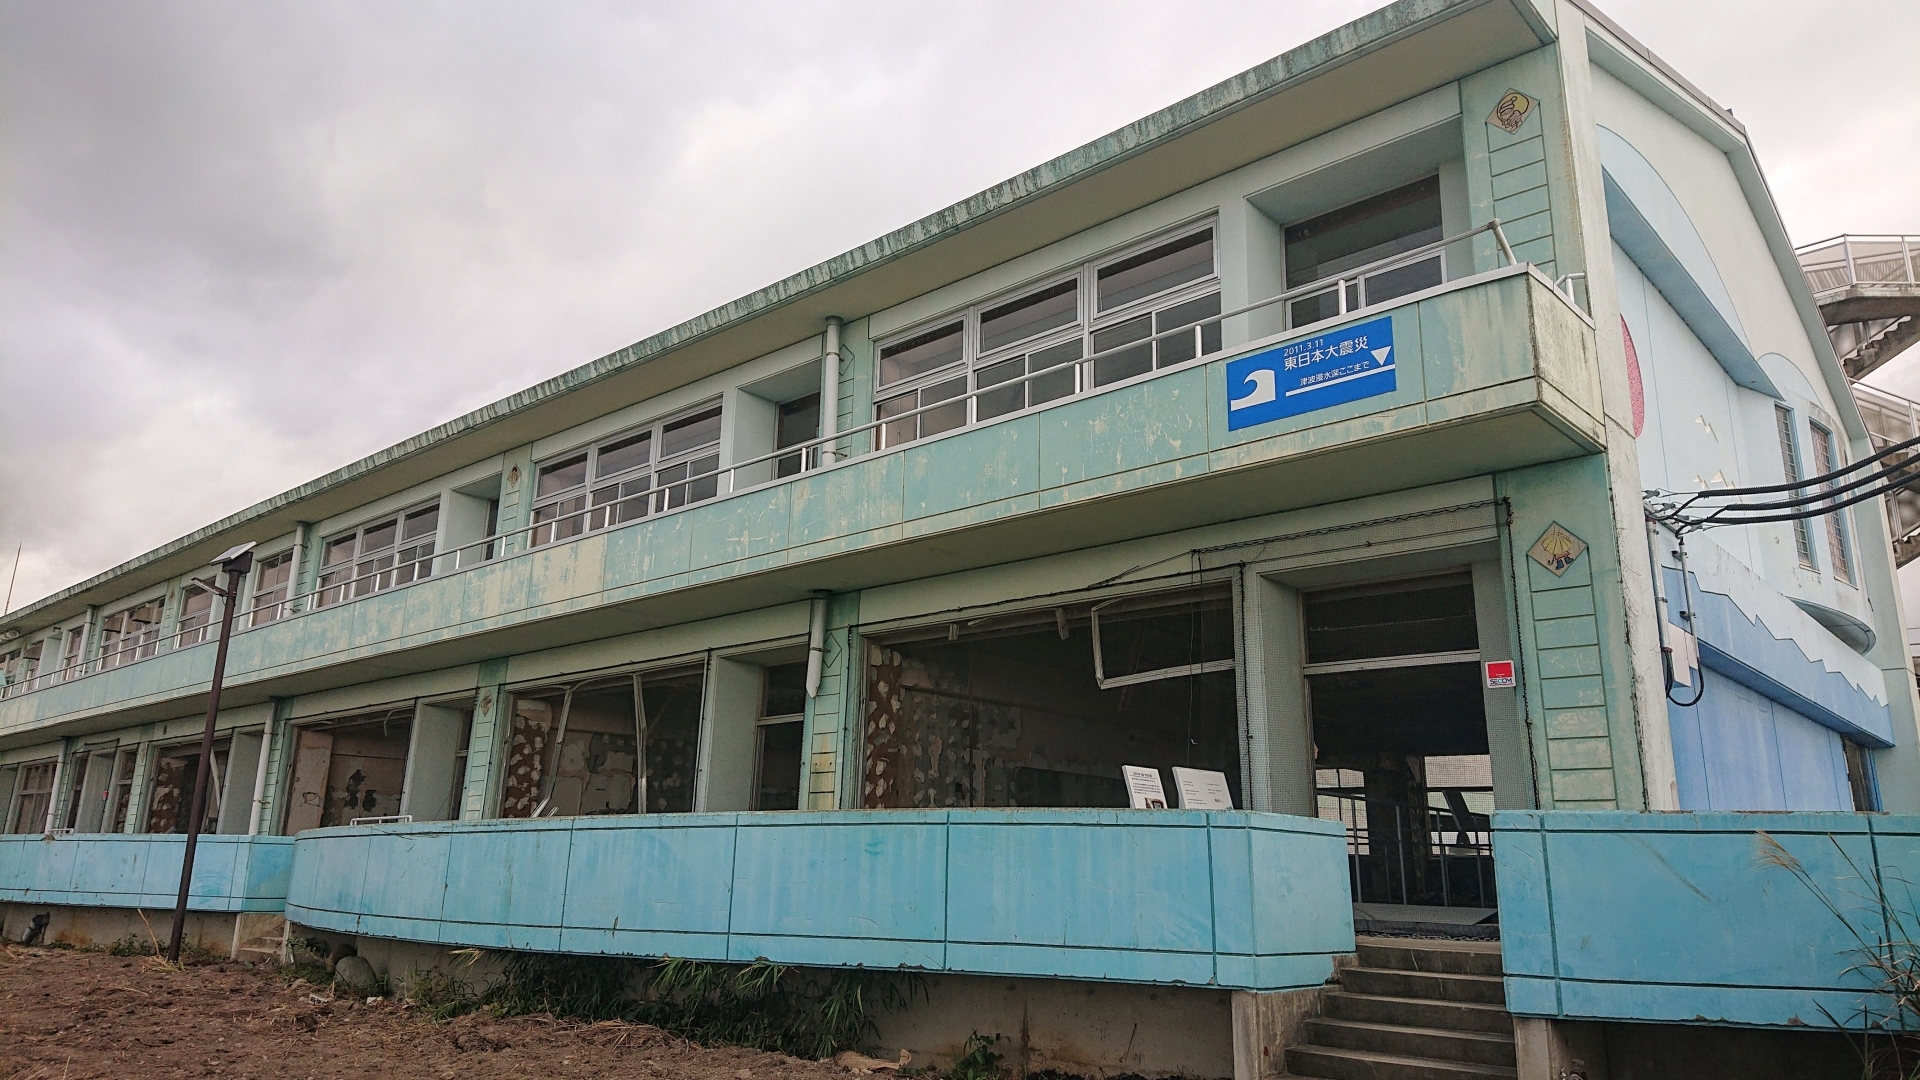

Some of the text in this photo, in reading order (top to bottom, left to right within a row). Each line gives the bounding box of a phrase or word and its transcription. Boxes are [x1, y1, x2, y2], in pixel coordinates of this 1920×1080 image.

[1283, 339, 1323, 357] 2011.3.11
[1284, 336, 1368, 371] 東日本大震災
[1300, 360, 1370, 386] 津波浸水深ここまで
[1489, 677, 1513, 685] SECOM
